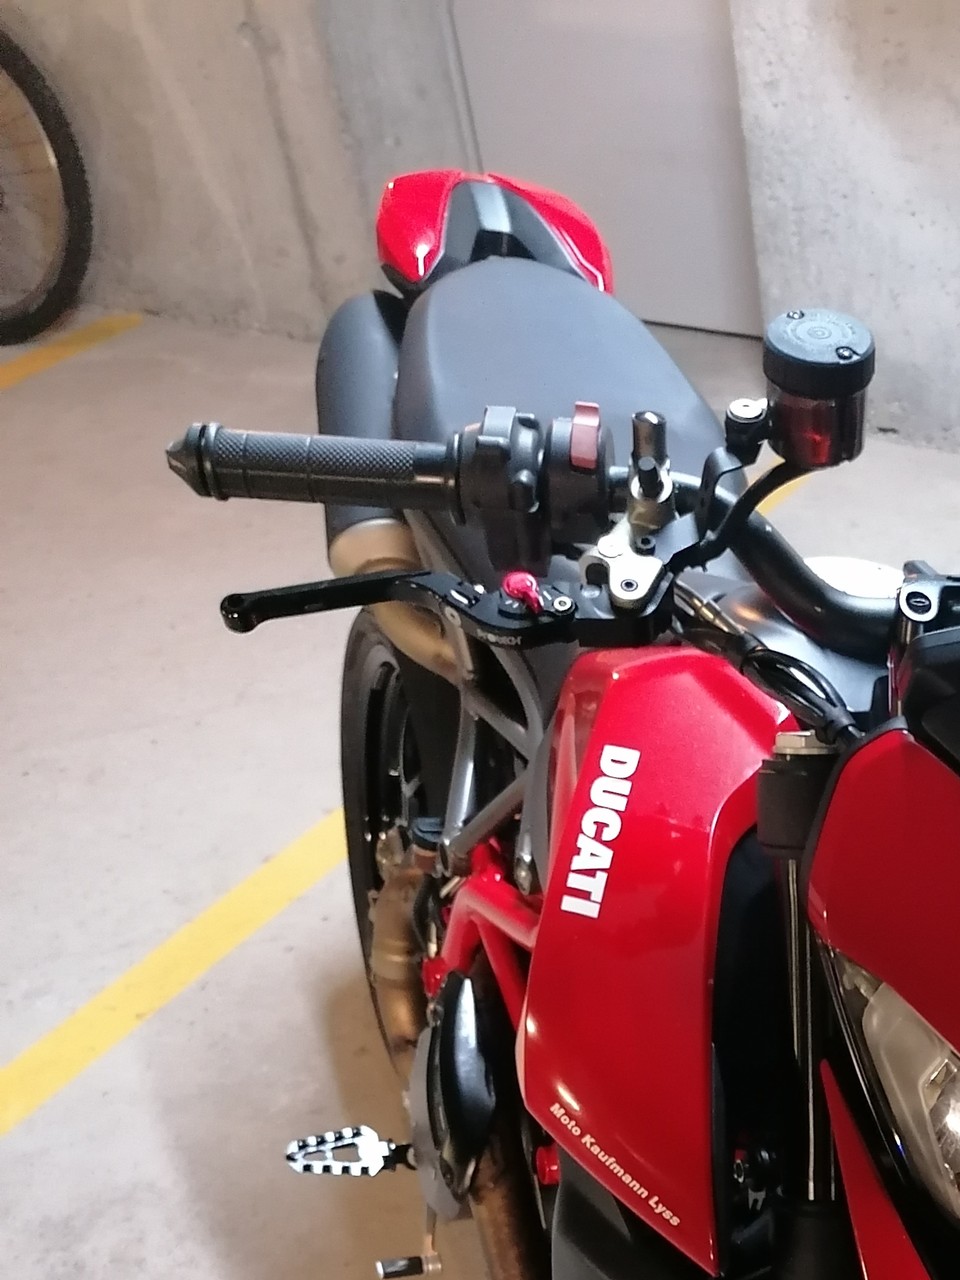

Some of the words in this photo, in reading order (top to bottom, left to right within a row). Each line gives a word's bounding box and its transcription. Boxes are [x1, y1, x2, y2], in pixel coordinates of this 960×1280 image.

[560, 744, 641, 919] DUCATI
[549, 1102, 581, 1136] Moto
[581, 1134, 649, 1199] Kaufmann
[648, 1196, 681, 1227] Lyss
